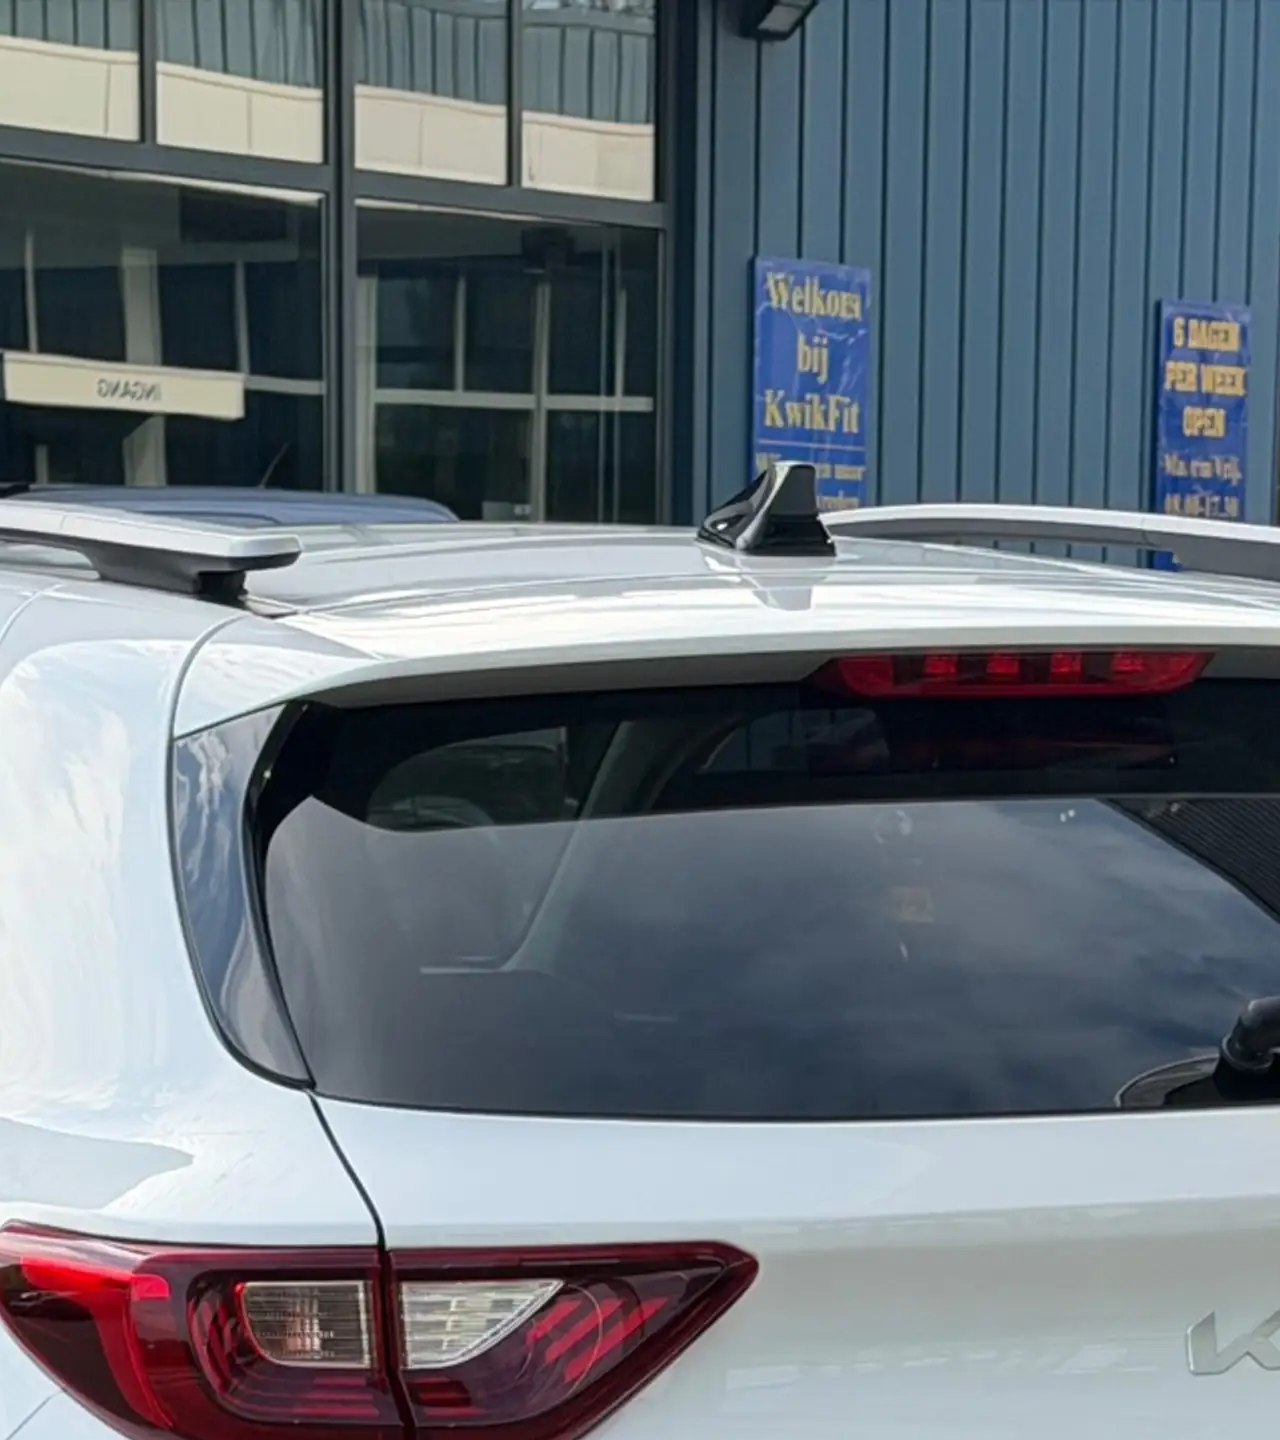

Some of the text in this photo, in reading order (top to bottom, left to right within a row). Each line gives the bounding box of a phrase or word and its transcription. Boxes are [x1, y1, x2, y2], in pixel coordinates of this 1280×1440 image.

[763, 271, 863, 321] Welkom
[796, 331, 830, 385] bij
[763, 388, 861, 434] KwikFit
[1182, 406, 1226, 438] OPEN
